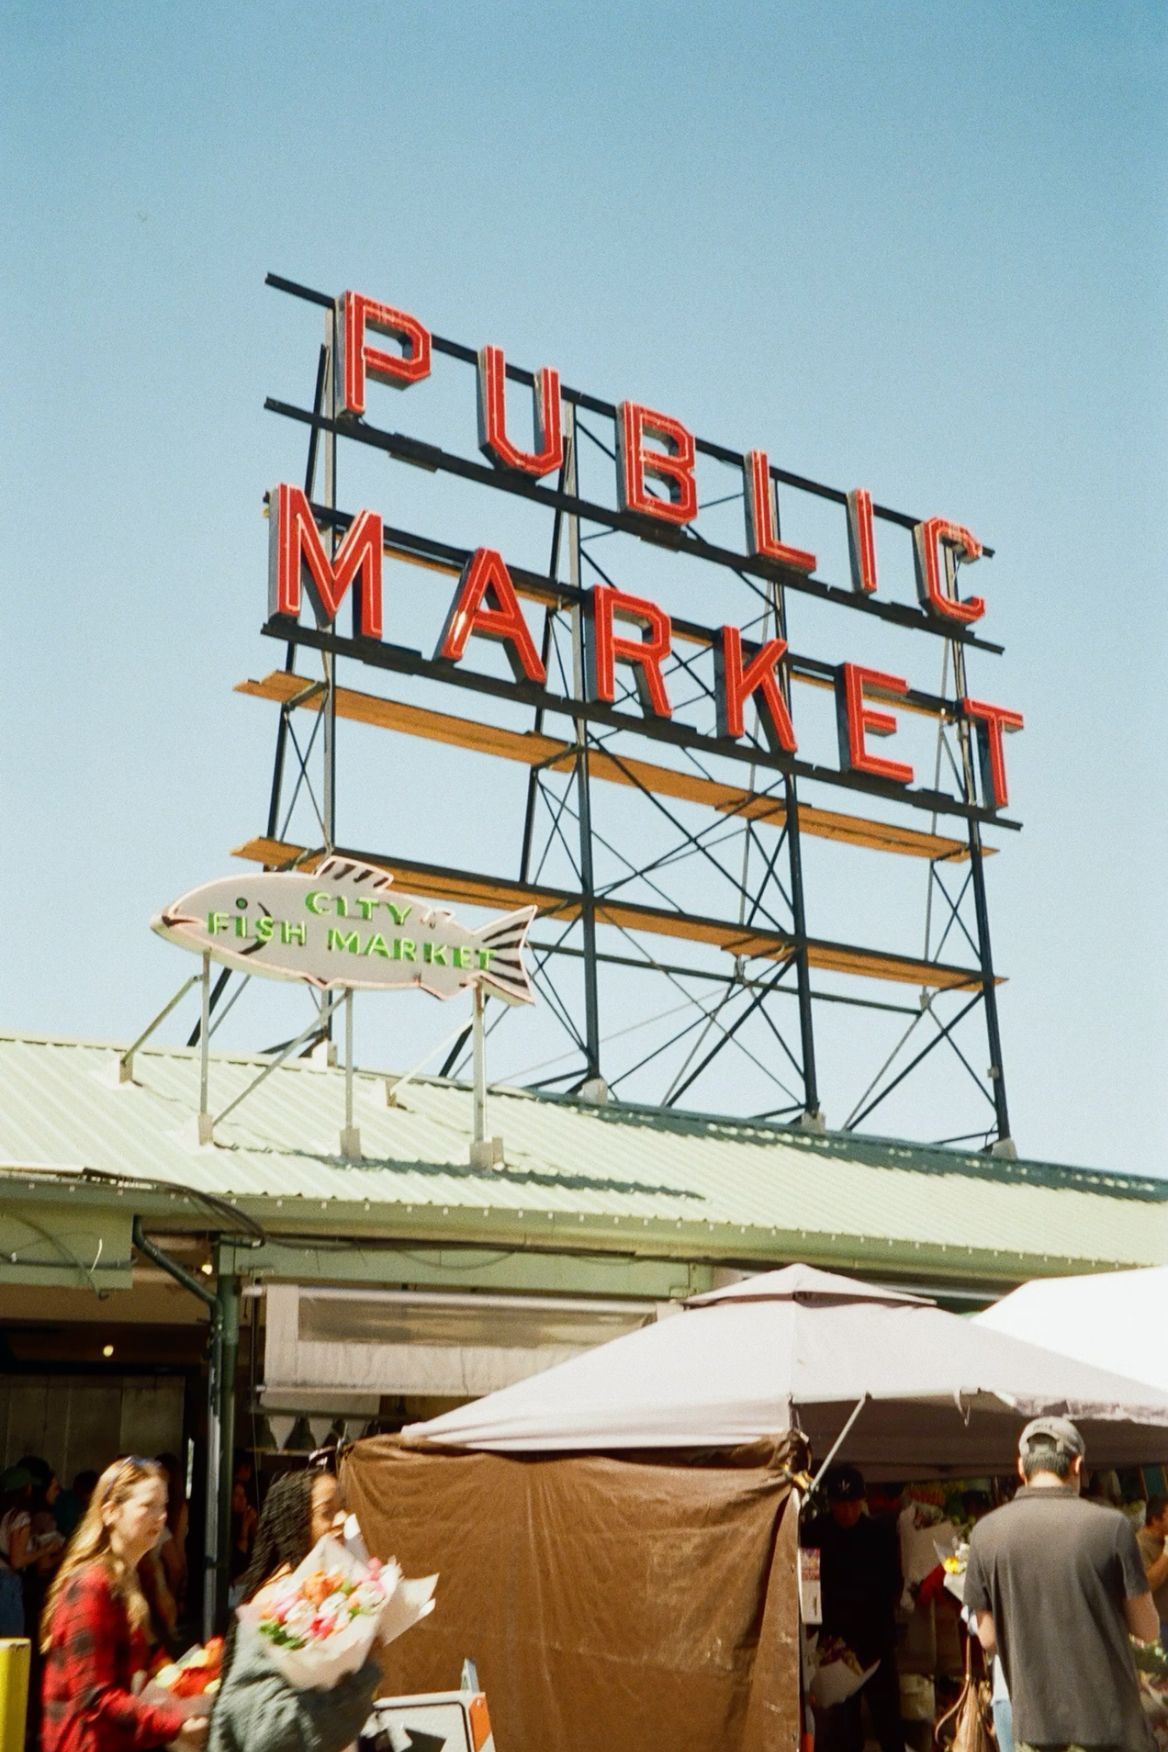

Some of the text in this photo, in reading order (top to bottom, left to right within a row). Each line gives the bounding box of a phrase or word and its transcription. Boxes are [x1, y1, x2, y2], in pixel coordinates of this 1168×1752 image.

[335, 290, 986, 626] PUBLIC
[268, 482, 1024, 809] MARKET
[207, 911, 497, 970] FISH MARKET
[304, 891, 412, 926] CITY
